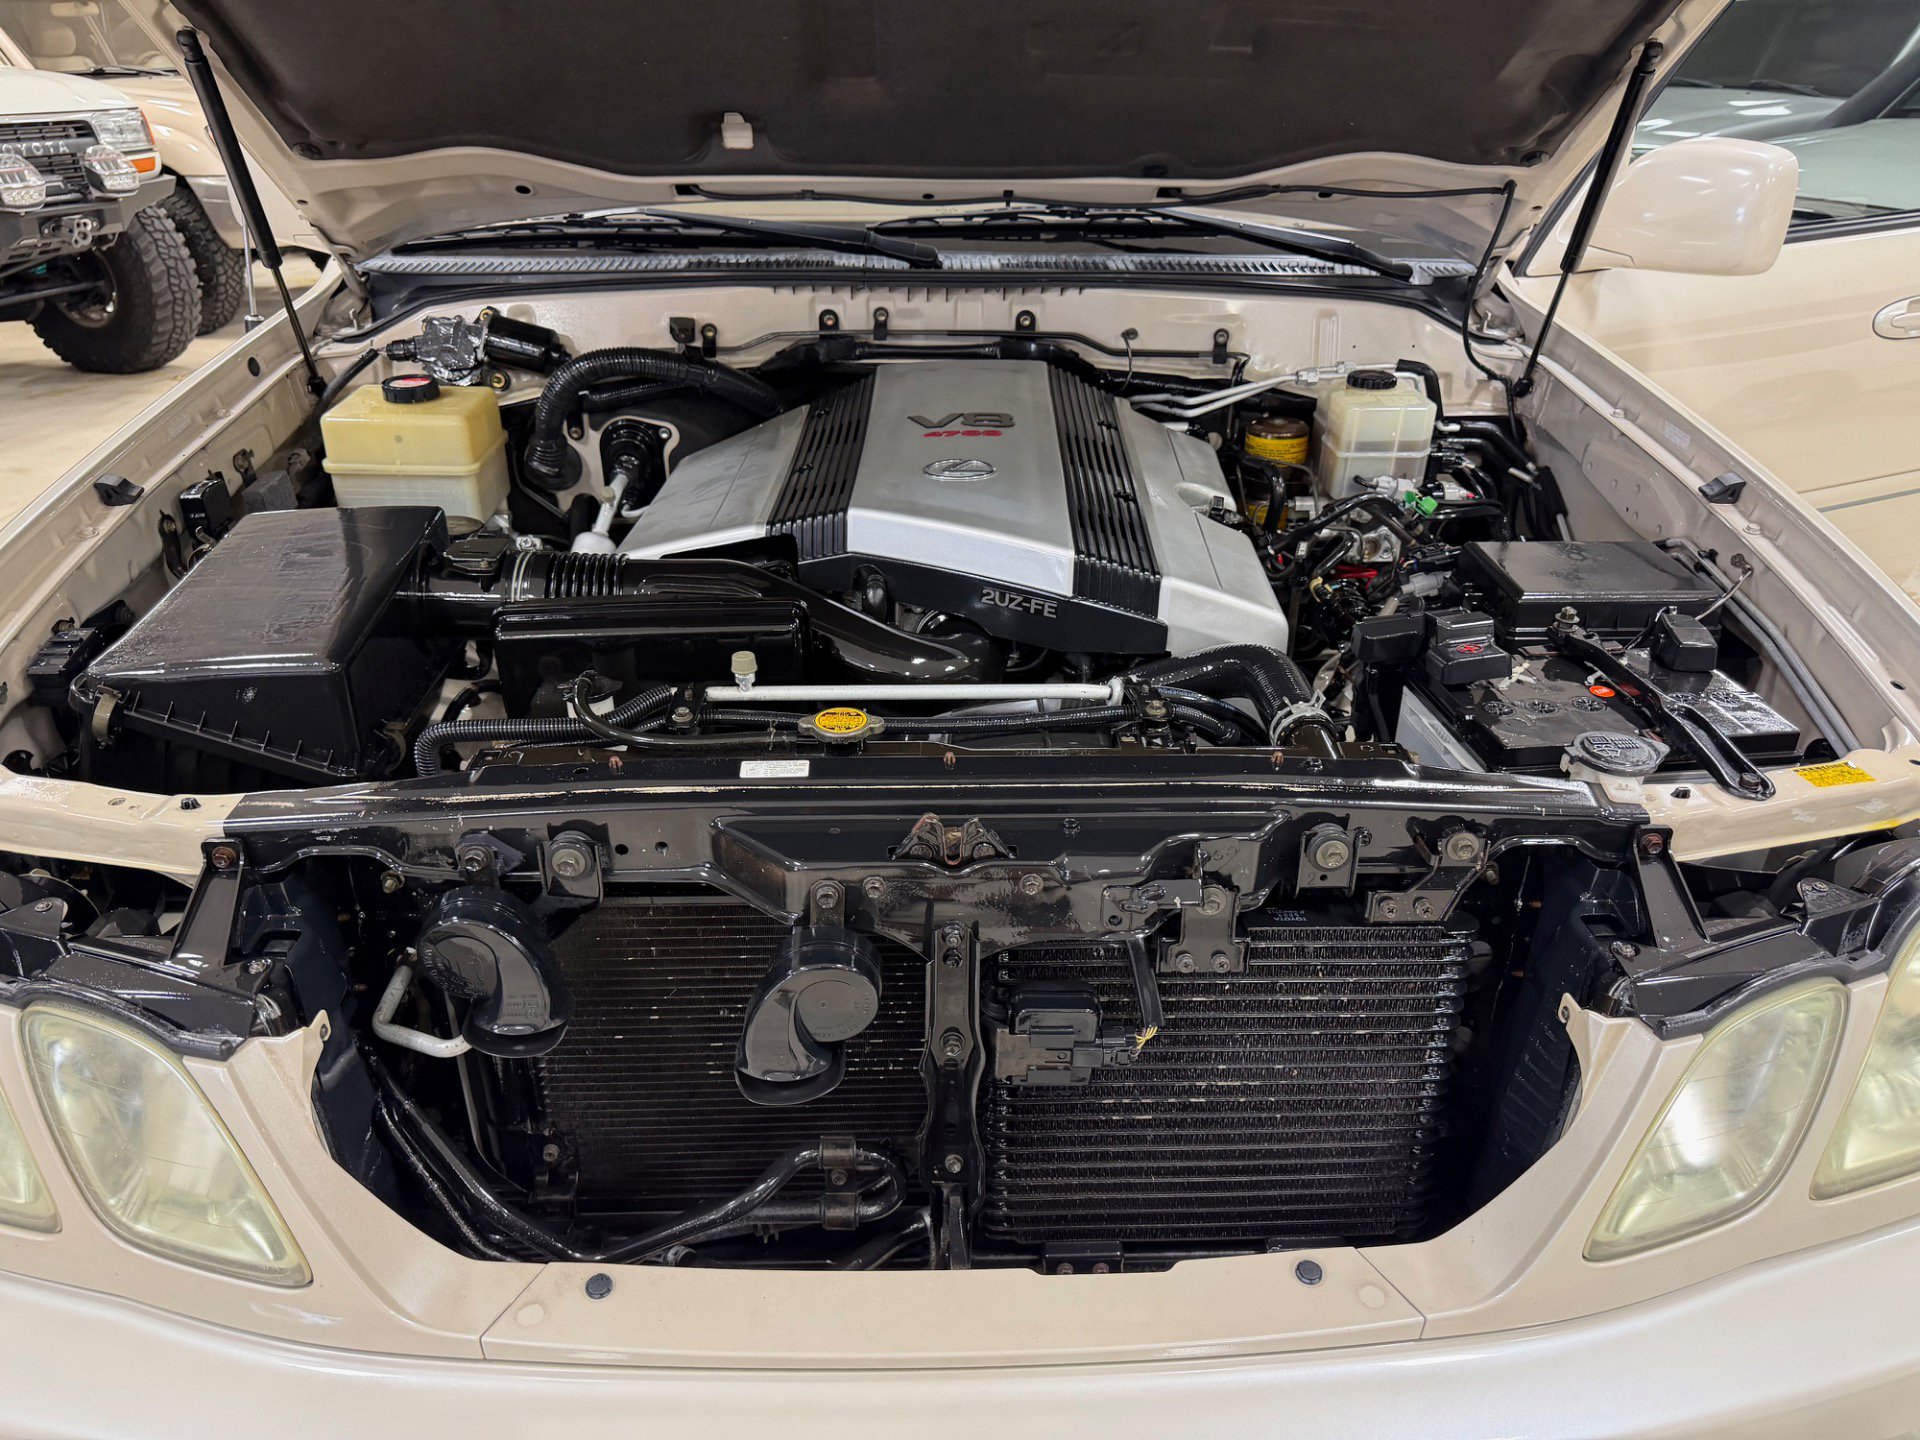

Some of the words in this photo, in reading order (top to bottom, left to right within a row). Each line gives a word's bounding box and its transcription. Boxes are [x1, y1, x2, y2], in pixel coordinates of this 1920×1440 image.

[1, 141, 69, 157] OYOTA
[907, 413, 1015, 428] V8
[981, 588, 1058, 618] 2UZ-FE
